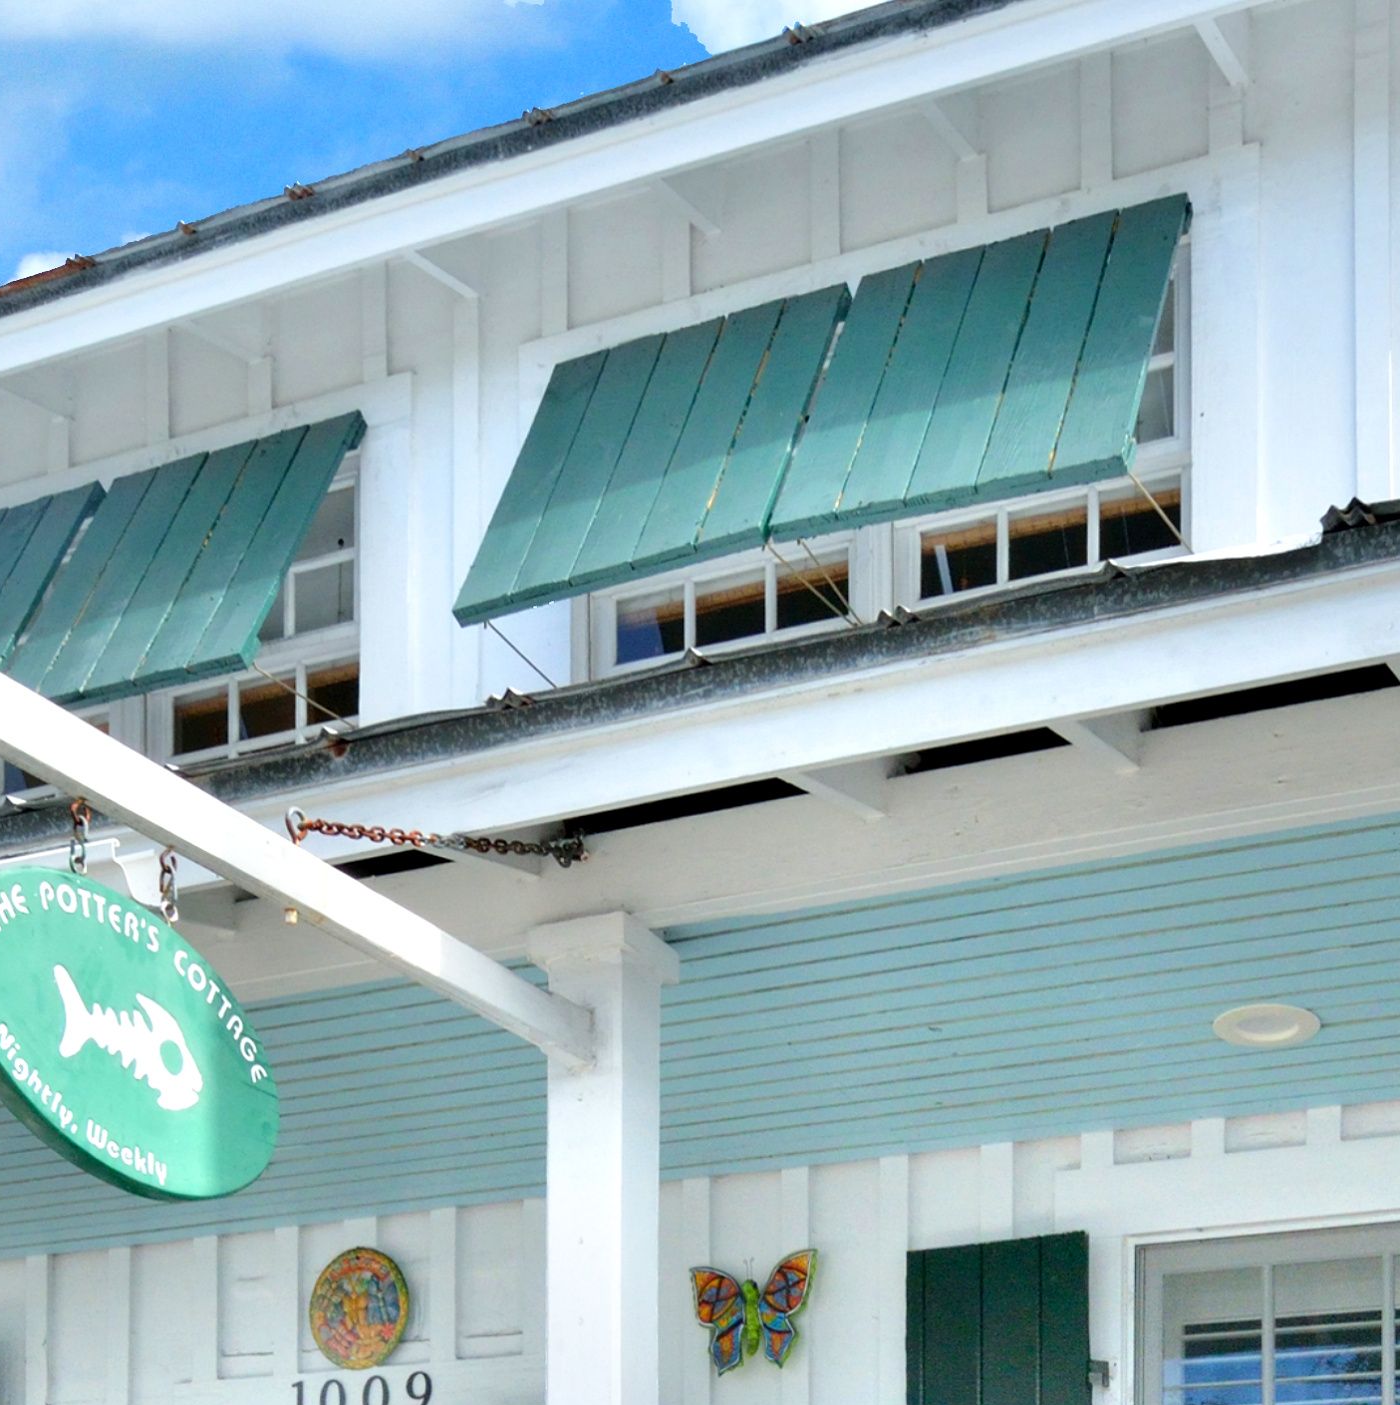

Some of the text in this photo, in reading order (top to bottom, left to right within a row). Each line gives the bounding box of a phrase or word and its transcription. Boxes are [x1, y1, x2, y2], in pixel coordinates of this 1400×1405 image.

[39, 880, 161, 952] POTTER'S
[173, 950, 268, 1084] COTTAGE
[86, 1119, 168, 1186] Weekly
